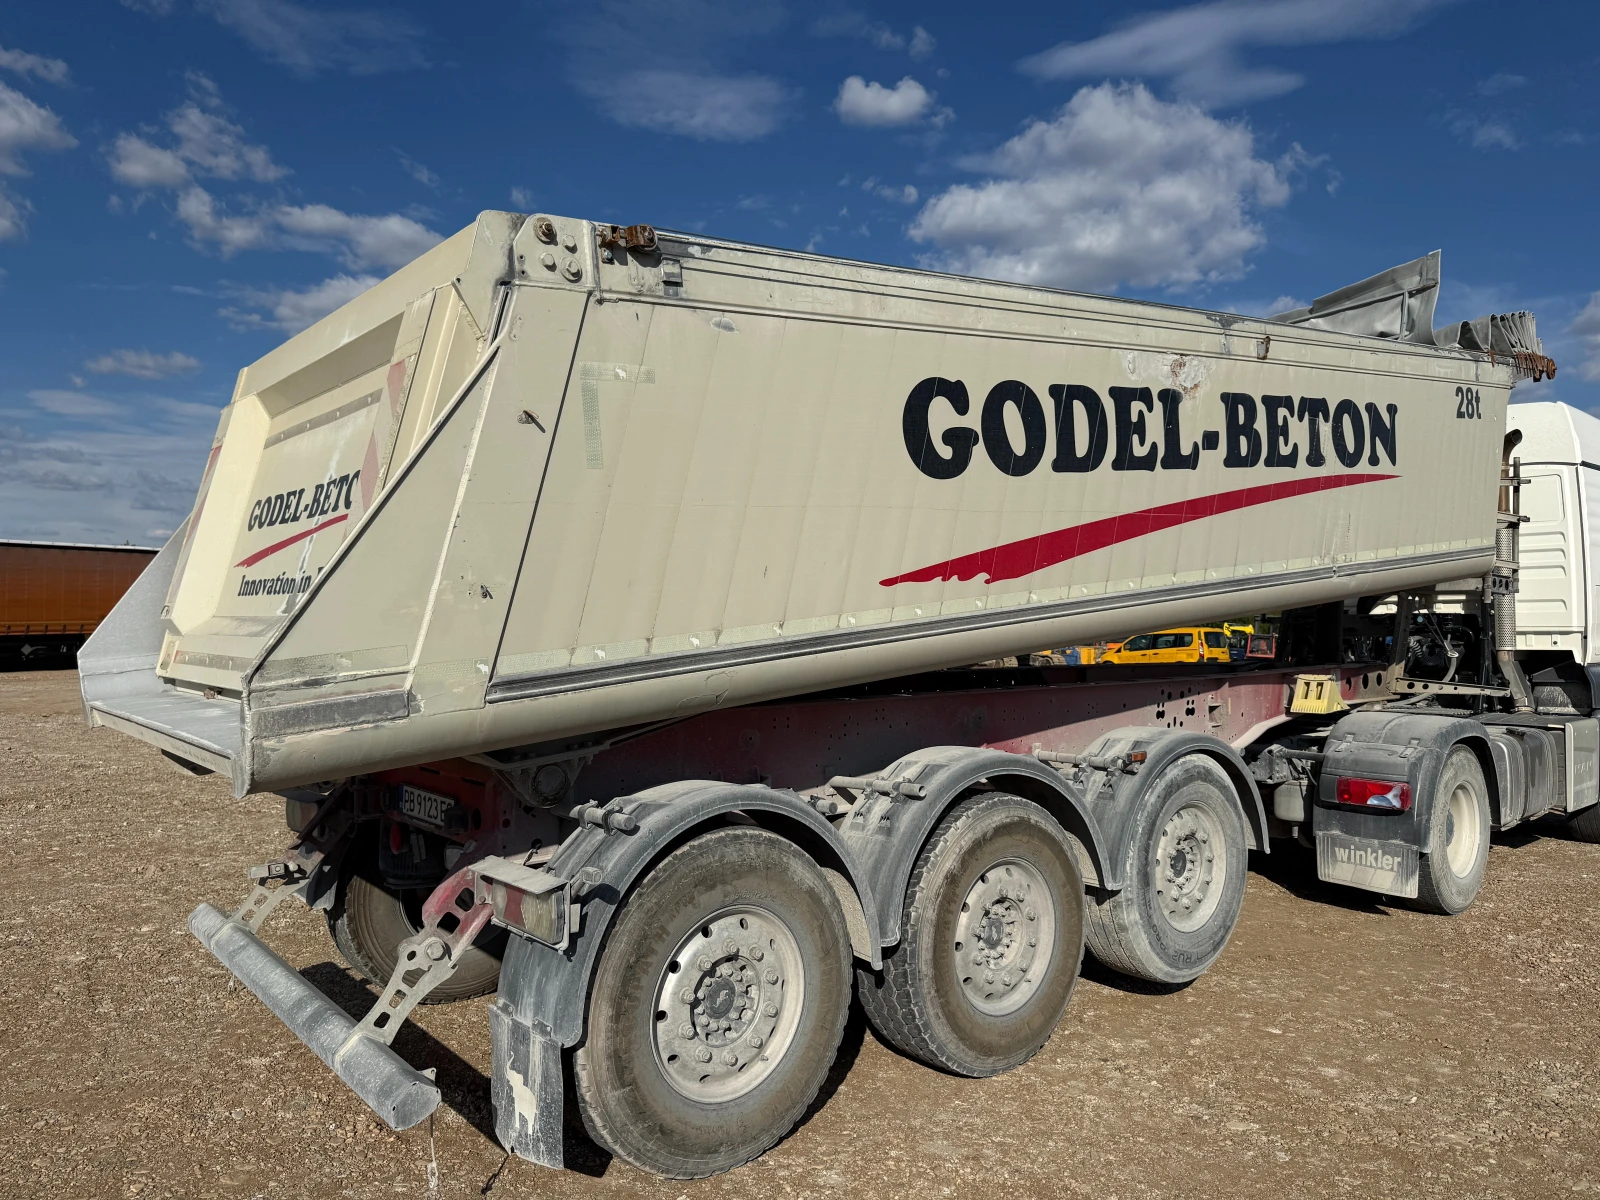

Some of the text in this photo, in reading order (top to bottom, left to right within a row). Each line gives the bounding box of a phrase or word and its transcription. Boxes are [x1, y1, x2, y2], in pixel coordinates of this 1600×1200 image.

[1455, 386, 1482, 419] 28t
[902, 376, 1398, 480] GODEL-BETON
[237, 571, 297, 597] Innovation
[417, 794, 439, 820] 9123
[1335, 845, 1402, 872] winkler
